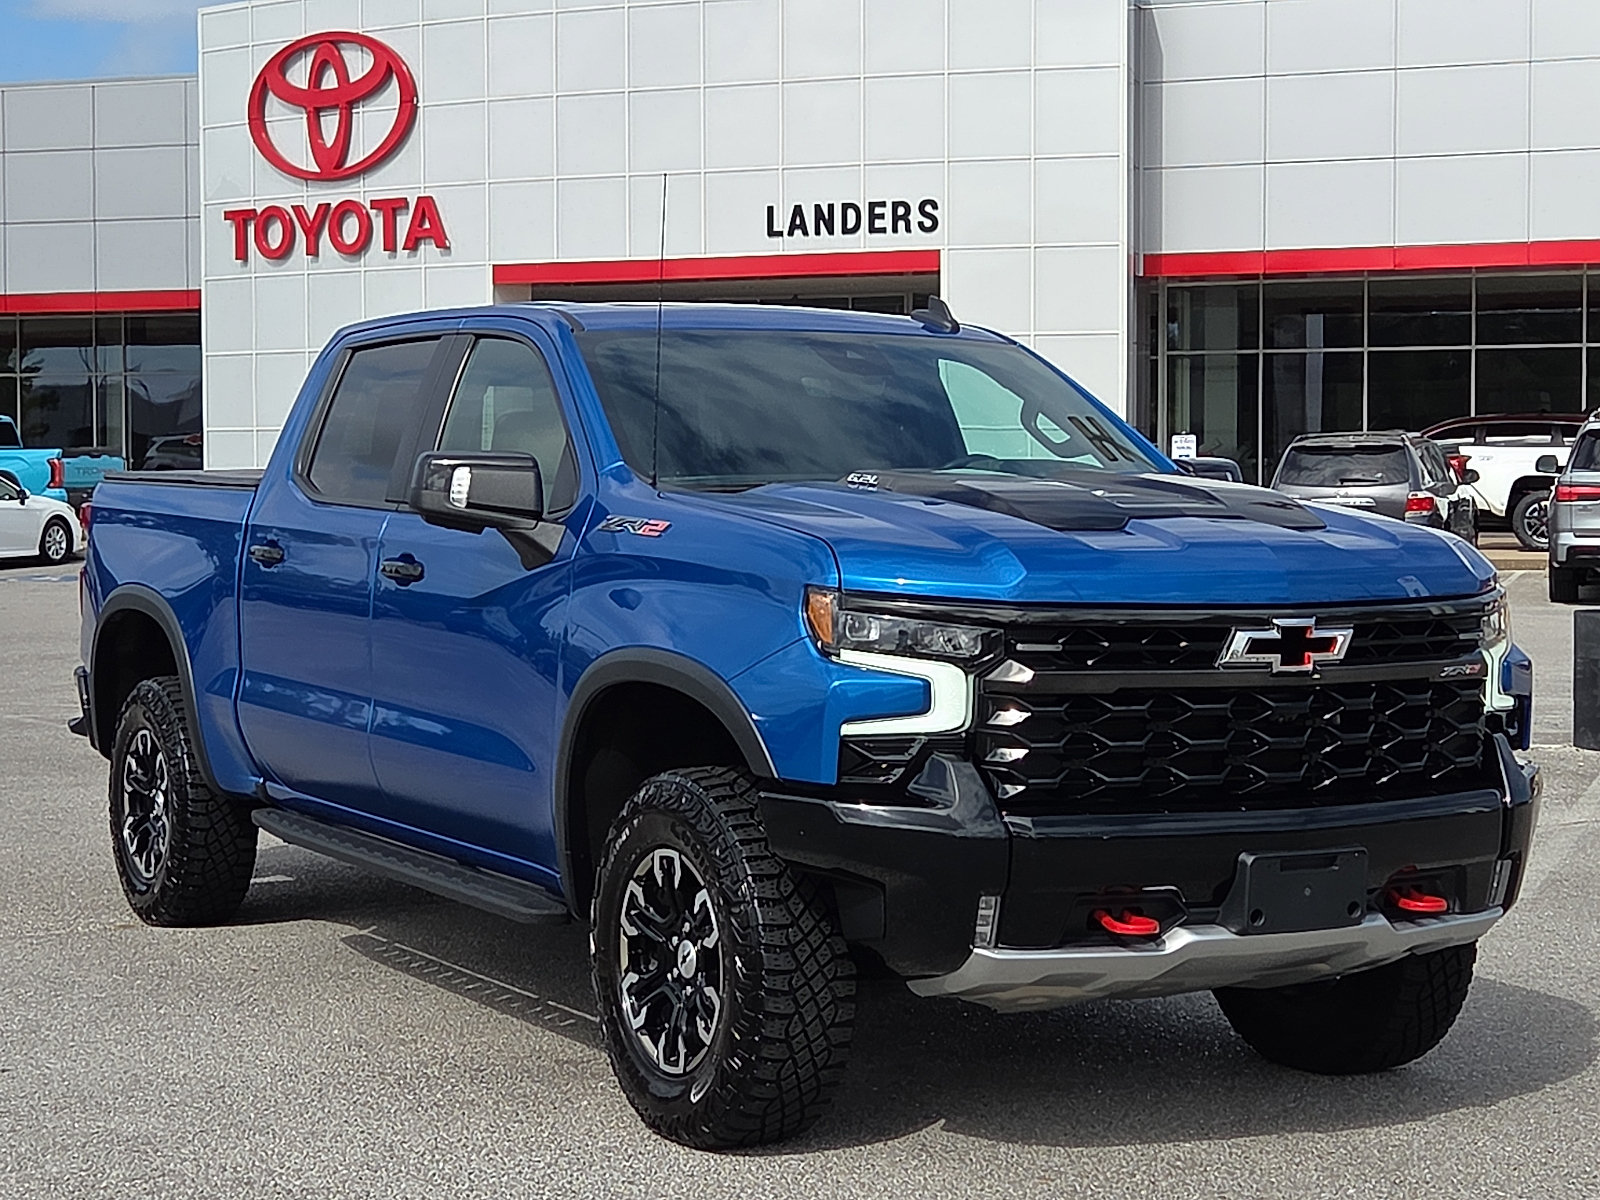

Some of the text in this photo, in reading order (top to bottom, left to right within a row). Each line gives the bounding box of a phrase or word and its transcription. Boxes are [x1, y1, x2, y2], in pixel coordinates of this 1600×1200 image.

[224, 195, 450, 261] TOYOTA
[766, 199, 939, 237] LANDERS
[599, 514, 672, 537] ZR2
